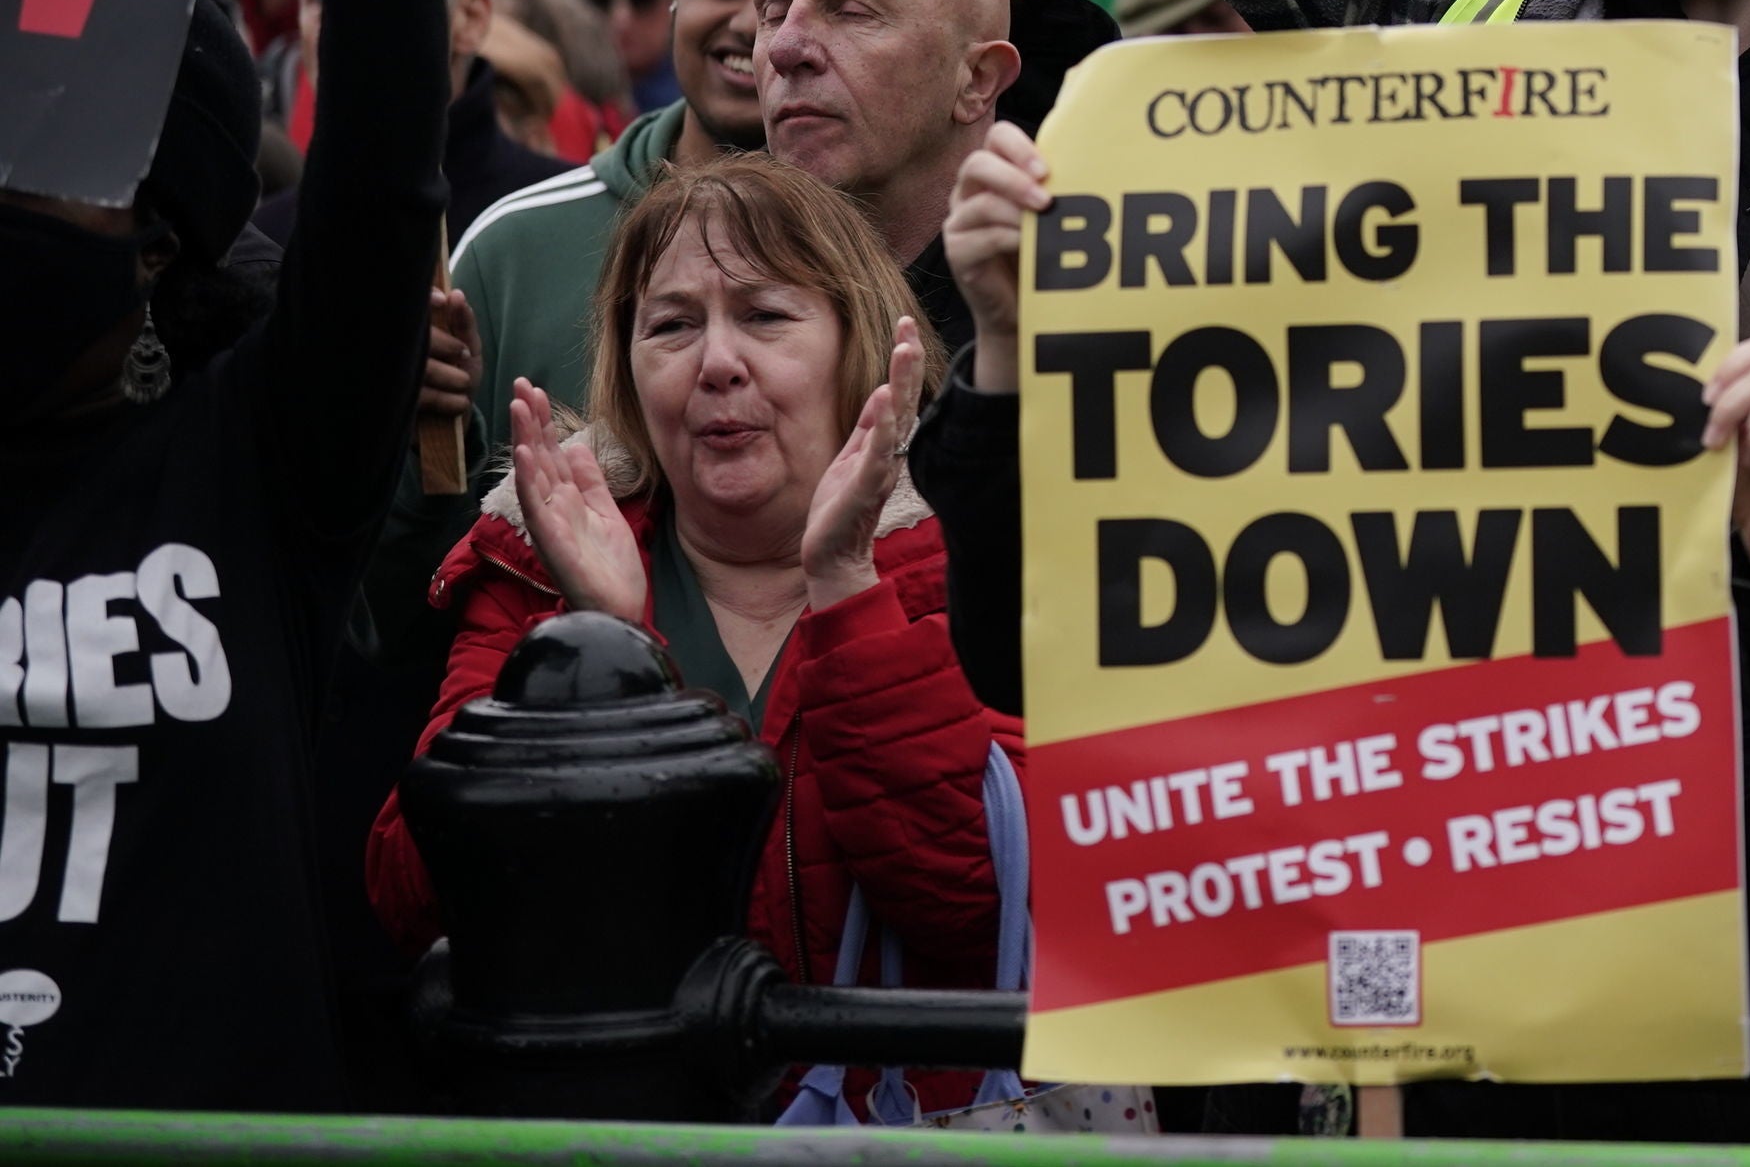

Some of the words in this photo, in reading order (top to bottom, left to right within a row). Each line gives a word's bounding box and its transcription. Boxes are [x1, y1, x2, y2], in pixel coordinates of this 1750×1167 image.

[1146, 66, 1610, 138] COUNTERFIRE
[1033, 181, 1419, 291] BRING
[1460, 176, 1720, 277] THE
[1034, 313, 1717, 480] TORIES
[1097, 506, 1662, 668] DOWN
[1060, 761, 1254, 847] UNITE
[1266, 733, 1402, 808] THE
[1417, 681, 1701, 782] STRIKES
[1105, 831, 1389, 934] PROTEST
[1447, 779, 1682, 872] RESIST
